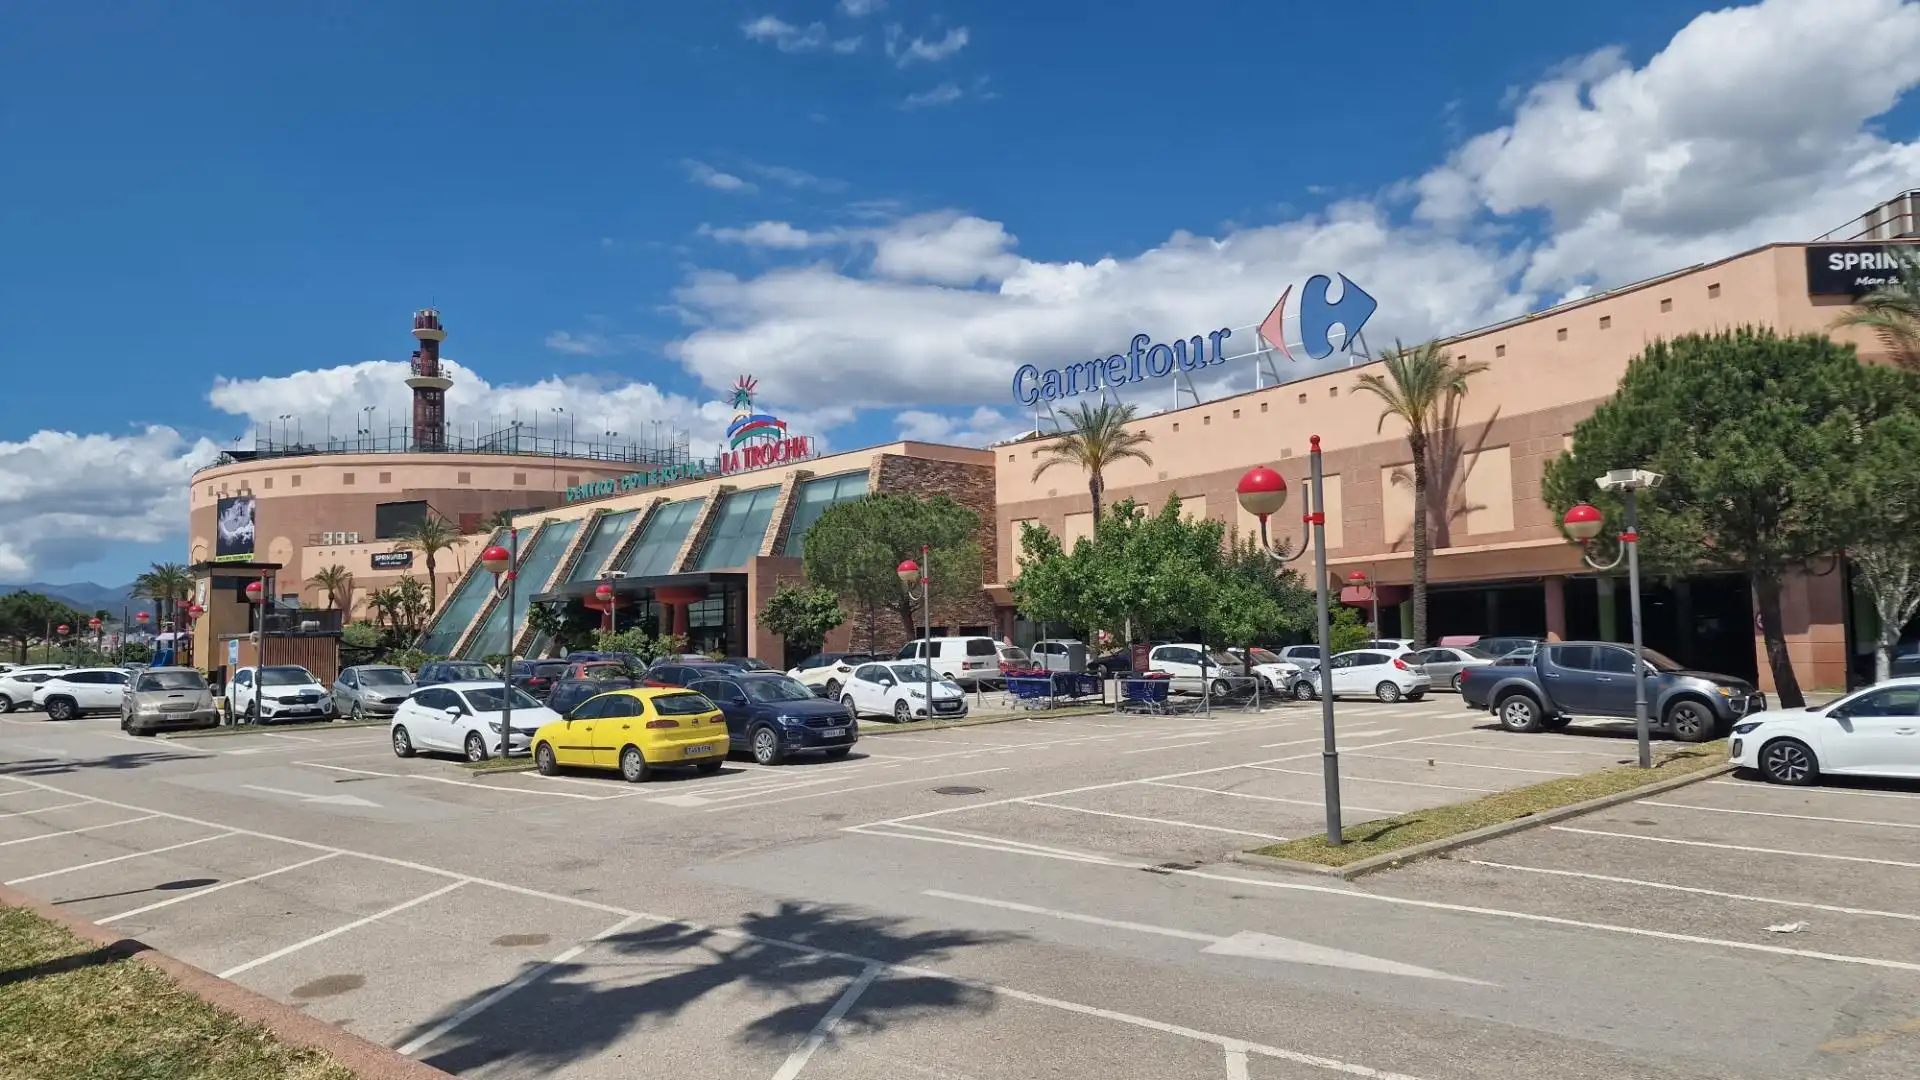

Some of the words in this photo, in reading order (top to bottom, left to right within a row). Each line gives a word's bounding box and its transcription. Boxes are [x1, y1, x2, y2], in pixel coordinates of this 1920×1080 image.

[1012, 327, 1232, 407] Carrefour
[722, 450, 740, 474] LA
[742, 435, 809, 469] TROCHA
[566, 478, 616, 502] CENTRO
